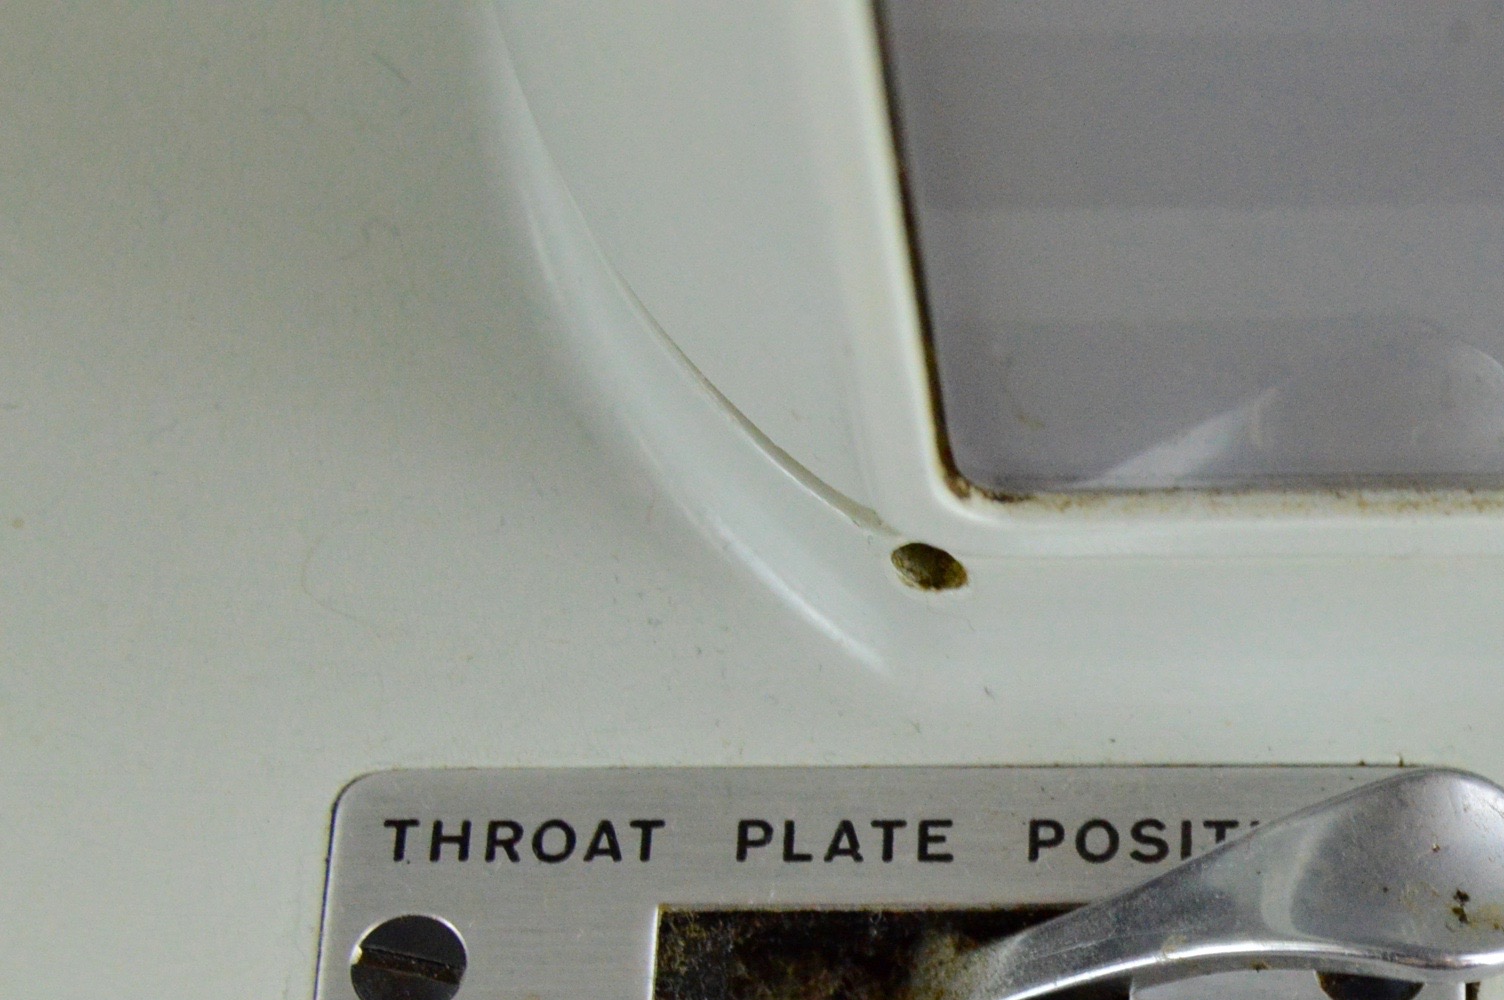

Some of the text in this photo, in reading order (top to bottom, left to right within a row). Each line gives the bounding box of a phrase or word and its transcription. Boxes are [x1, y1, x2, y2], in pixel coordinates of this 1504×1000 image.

[383, 818, 1261, 865] THROAT PLATE POSIT
